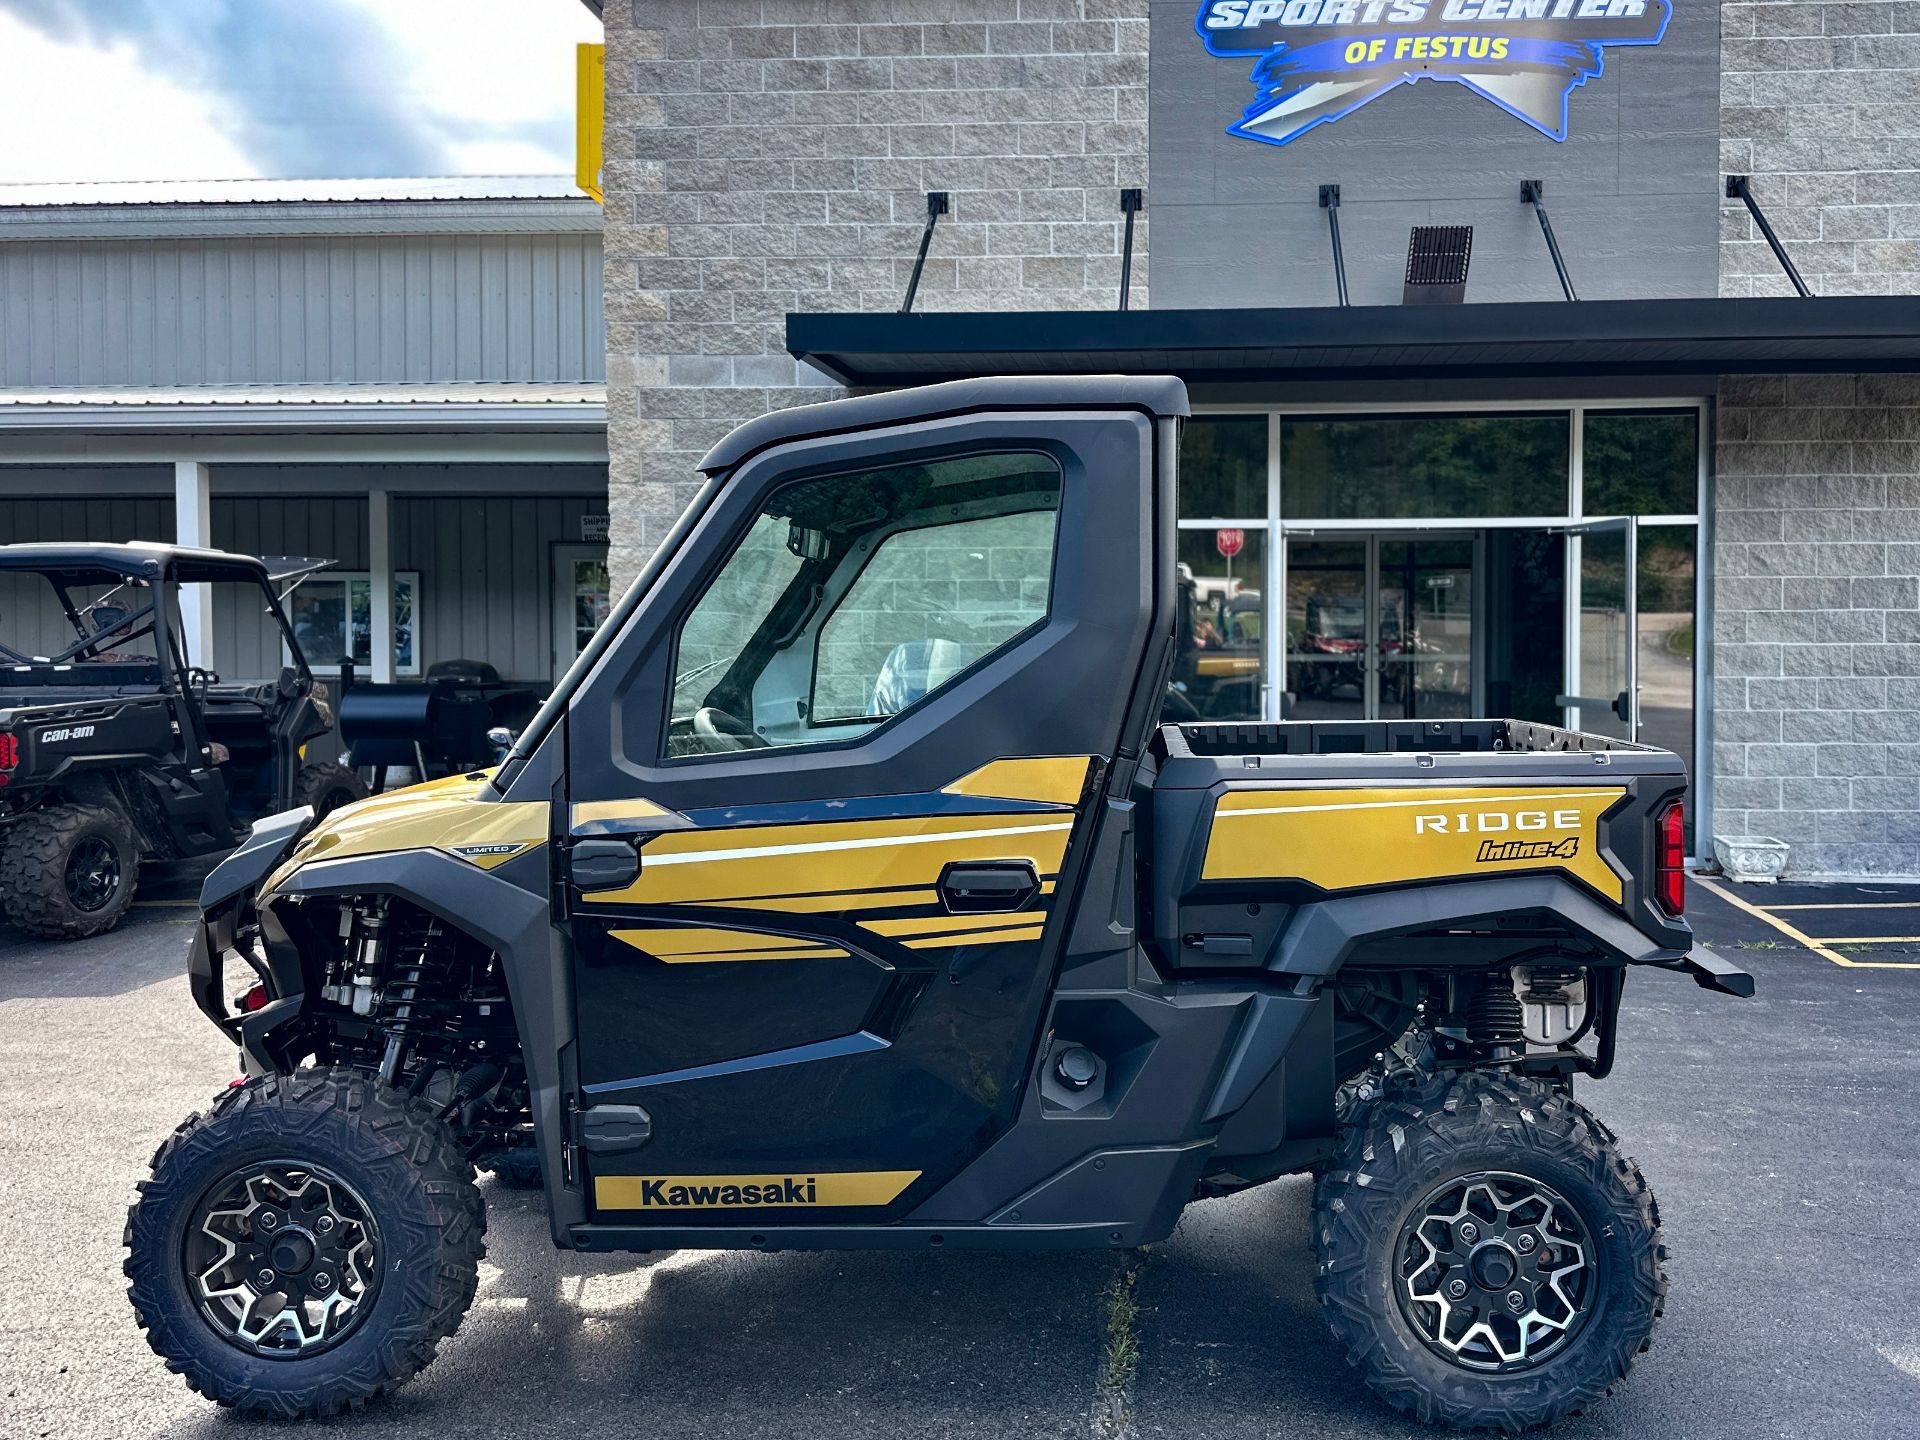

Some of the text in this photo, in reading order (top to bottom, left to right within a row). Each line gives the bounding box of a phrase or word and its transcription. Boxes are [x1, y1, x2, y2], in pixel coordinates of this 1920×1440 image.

[1205, 0, 1646, 28] SPORTS CENTER
[1345, 37, 1509, 64] OF FESTUS
[42, 725, 95, 743] can-am
[1415, 809, 1582, 835] RIDGE
[466, 846, 509, 854] LIMITED
[1476, 836, 1580, 862] Inline-4
[641, 1177, 817, 1206] Kawasaki
